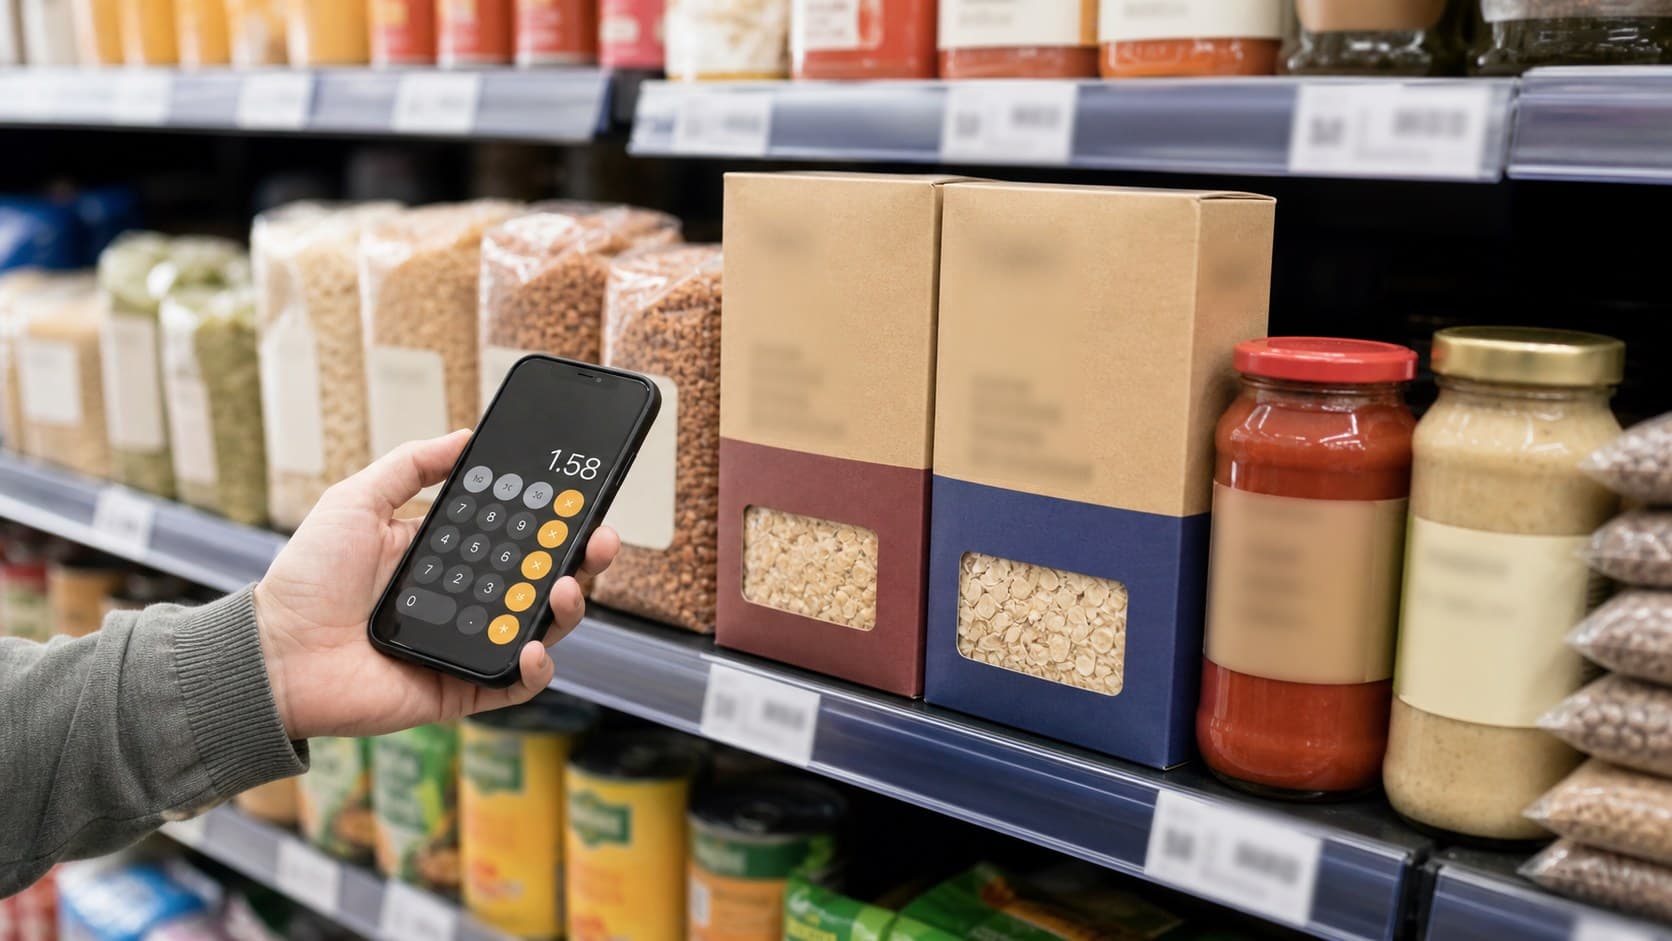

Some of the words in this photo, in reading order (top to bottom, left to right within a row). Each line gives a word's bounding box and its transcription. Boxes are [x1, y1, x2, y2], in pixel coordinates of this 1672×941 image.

[548, 449, 601, 480] 1.58
[456, 503, 468, 515] 7
[486, 511, 497, 523] 8
[516, 519, 527, 531] 9
[440, 533, 451, 545] 4
[470, 541, 481, 553] 5
[500, 550, 511, 562] 6
[452, 572, 464, 585] 2
[483, 582, 494, 594] 3
[406, 595, 417, 607] 0
